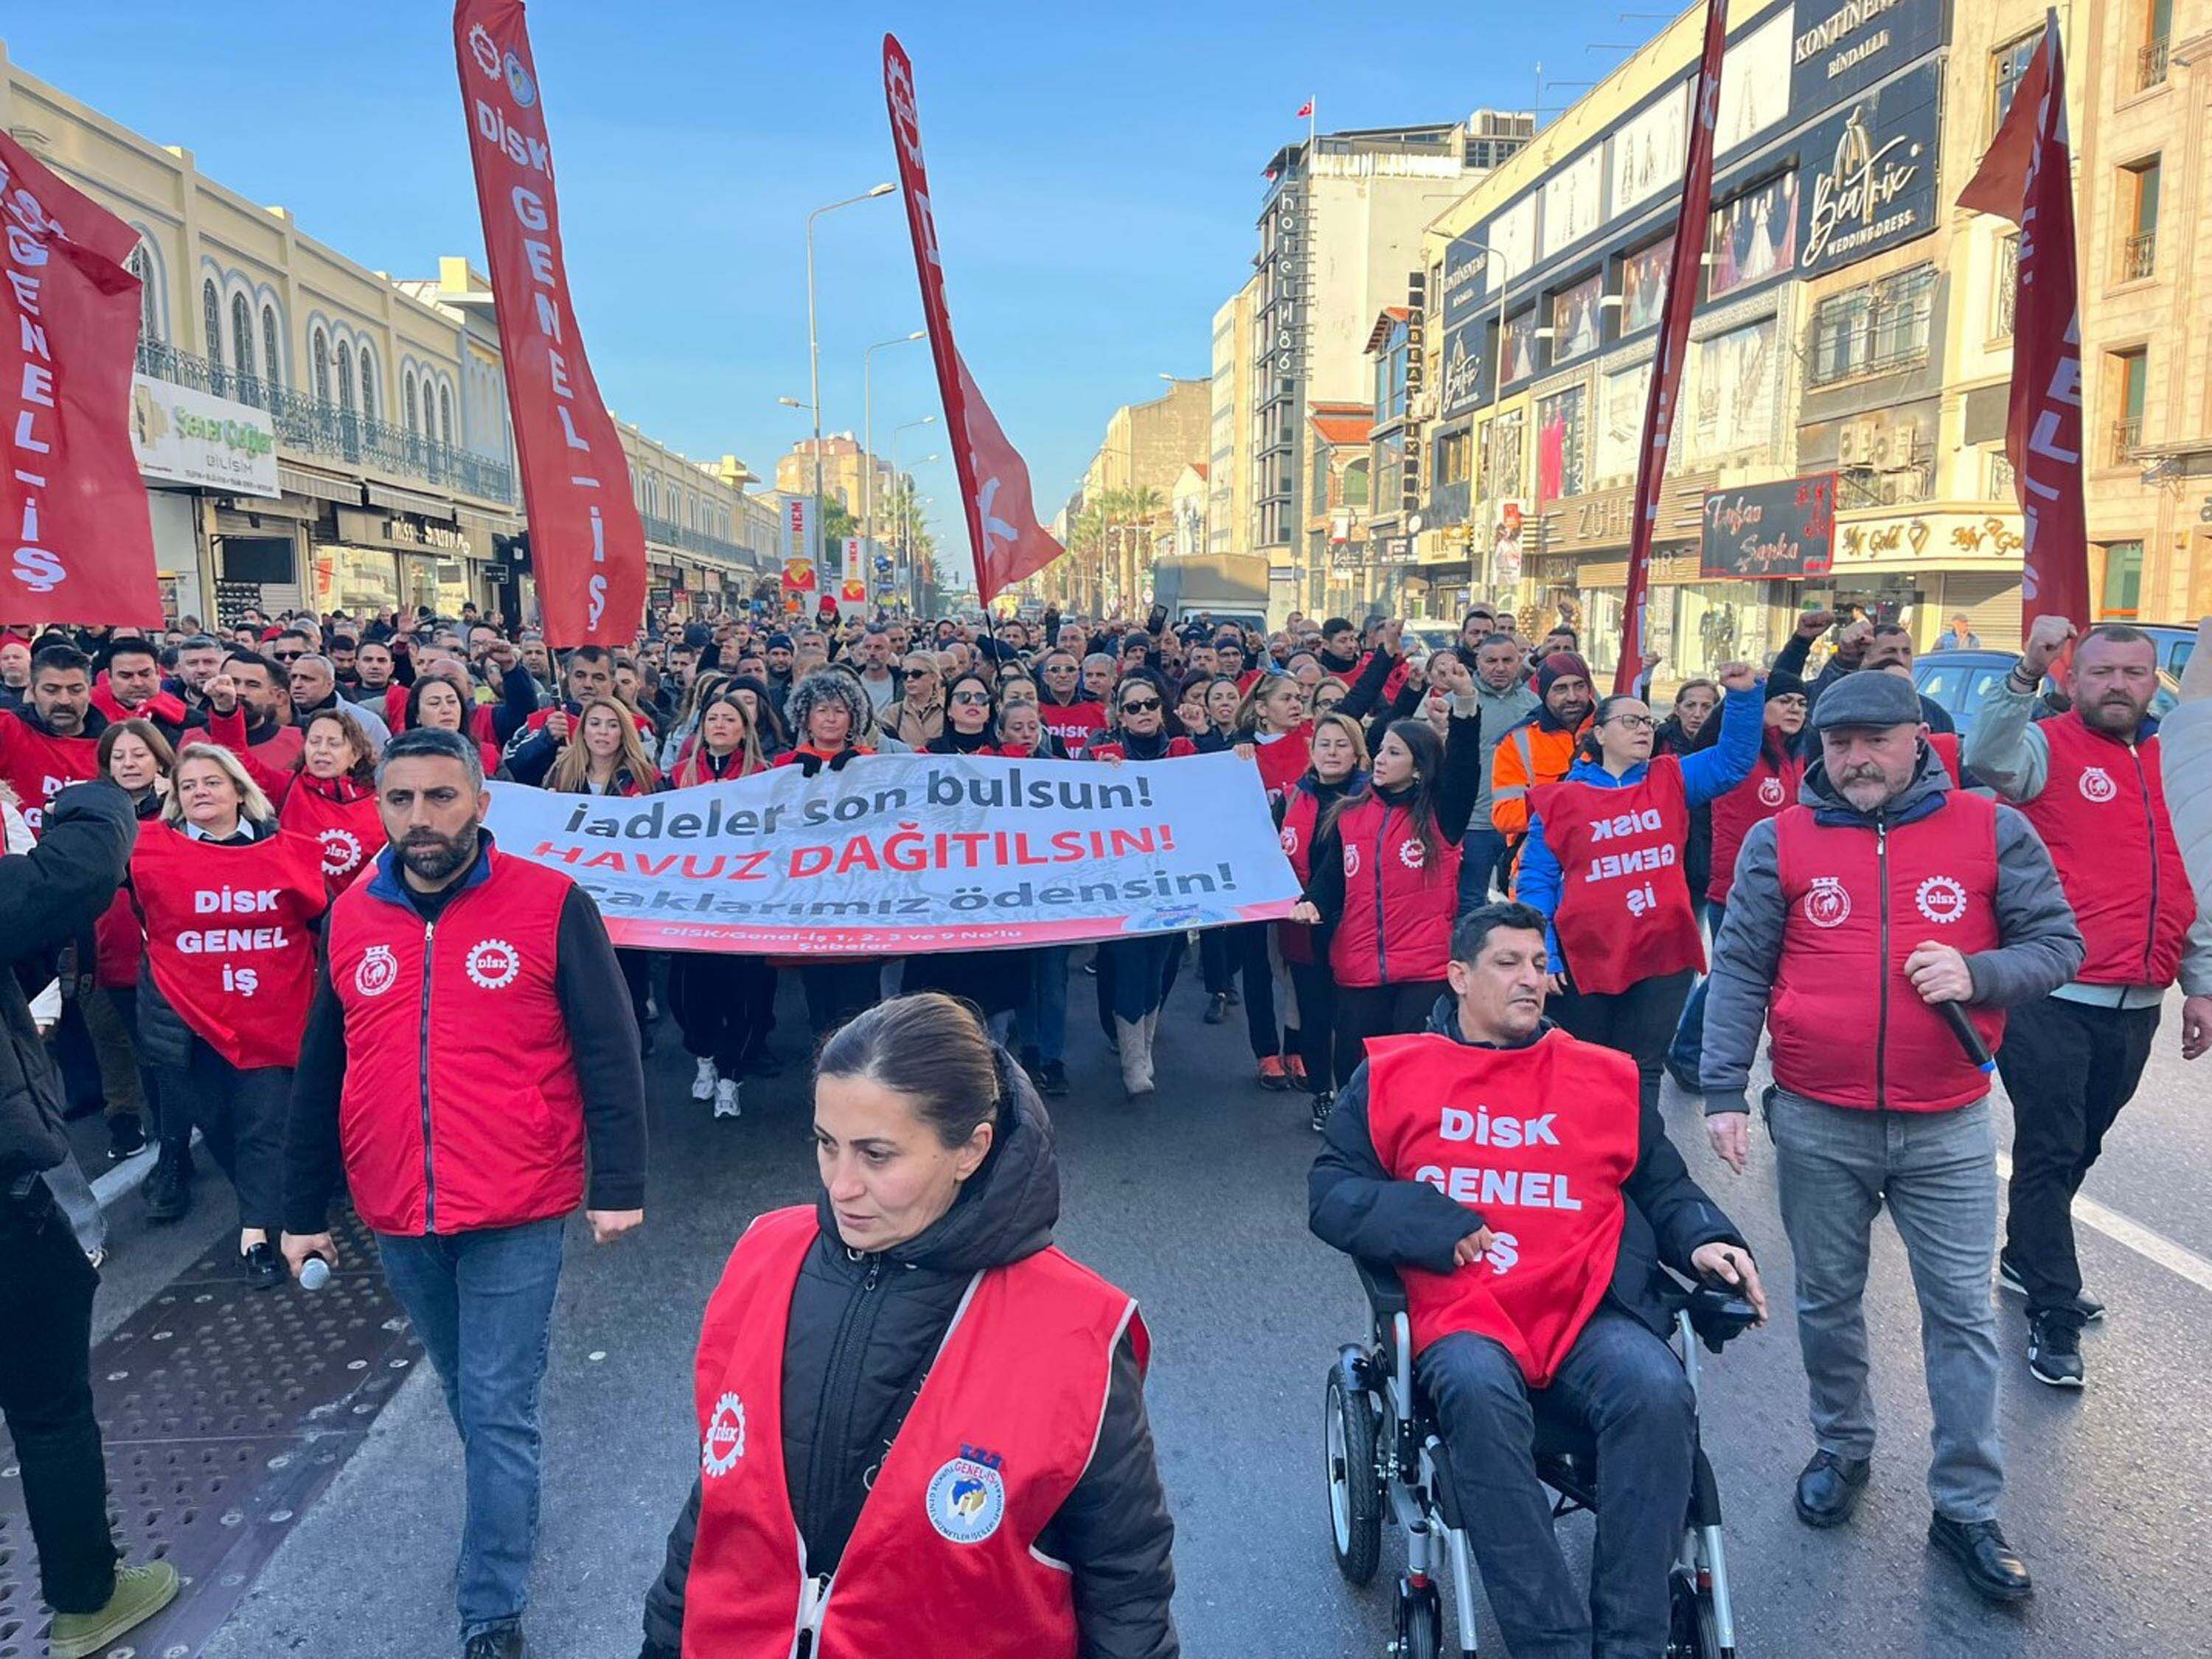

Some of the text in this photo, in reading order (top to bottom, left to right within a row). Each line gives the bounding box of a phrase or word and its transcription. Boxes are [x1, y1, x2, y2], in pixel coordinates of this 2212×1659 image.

[1827, 223, 1874, 257] WEDDING
[804, 787, 907, 827] son
[927, 768, 1154, 809] bulsun!
[532, 822, 1175, 880] HAVUZ DAĞITILSIN!
[195, 886, 282, 914] DİSK
[949, 863, 1237, 912] ödensin!
[176, 926, 288, 954] GENEL
[223, 964, 259, 996] İŞ
[1440, 1105, 1561, 1148] DİSK
